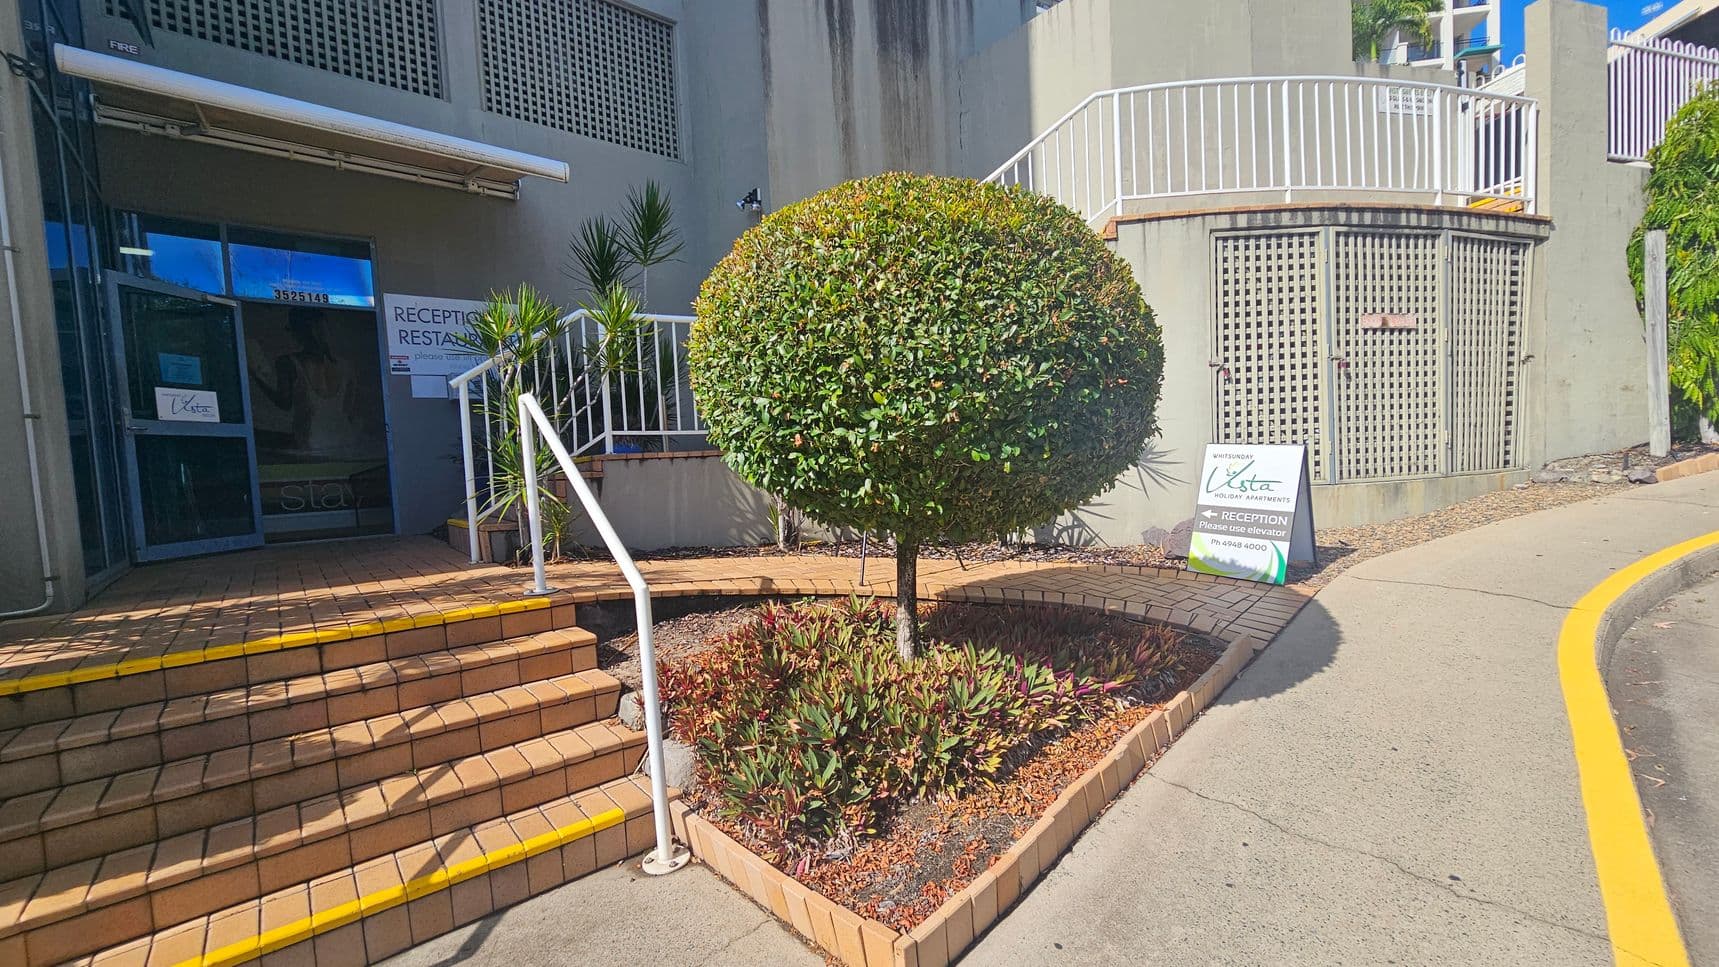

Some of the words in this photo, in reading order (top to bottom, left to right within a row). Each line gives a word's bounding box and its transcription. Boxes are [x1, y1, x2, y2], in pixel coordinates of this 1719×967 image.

[109, 40, 139, 55] FIRE
[274, 289, 329, 303] 3525149
[394, 306, 482, 326] RECEPTIO
[414, 352, 443, 361] please
[1206, 460, 1283, 493] Vista
[1214, 492, 1242, 500] HOLIDAY
[1245, 495, 1291, 503] APARTMENTS
[1221, 511, 1288, 526] RECEPTION
[1199, 520, 1229, 531] Please
[1229, 524, 1246, 533] use
[1247, 525, 1287, 537] elevator
[1210, 538, 1221, 546] Ph
[1222, 540, 1243, 549] 4948
[1243, 543, 1268, 552] 4000
